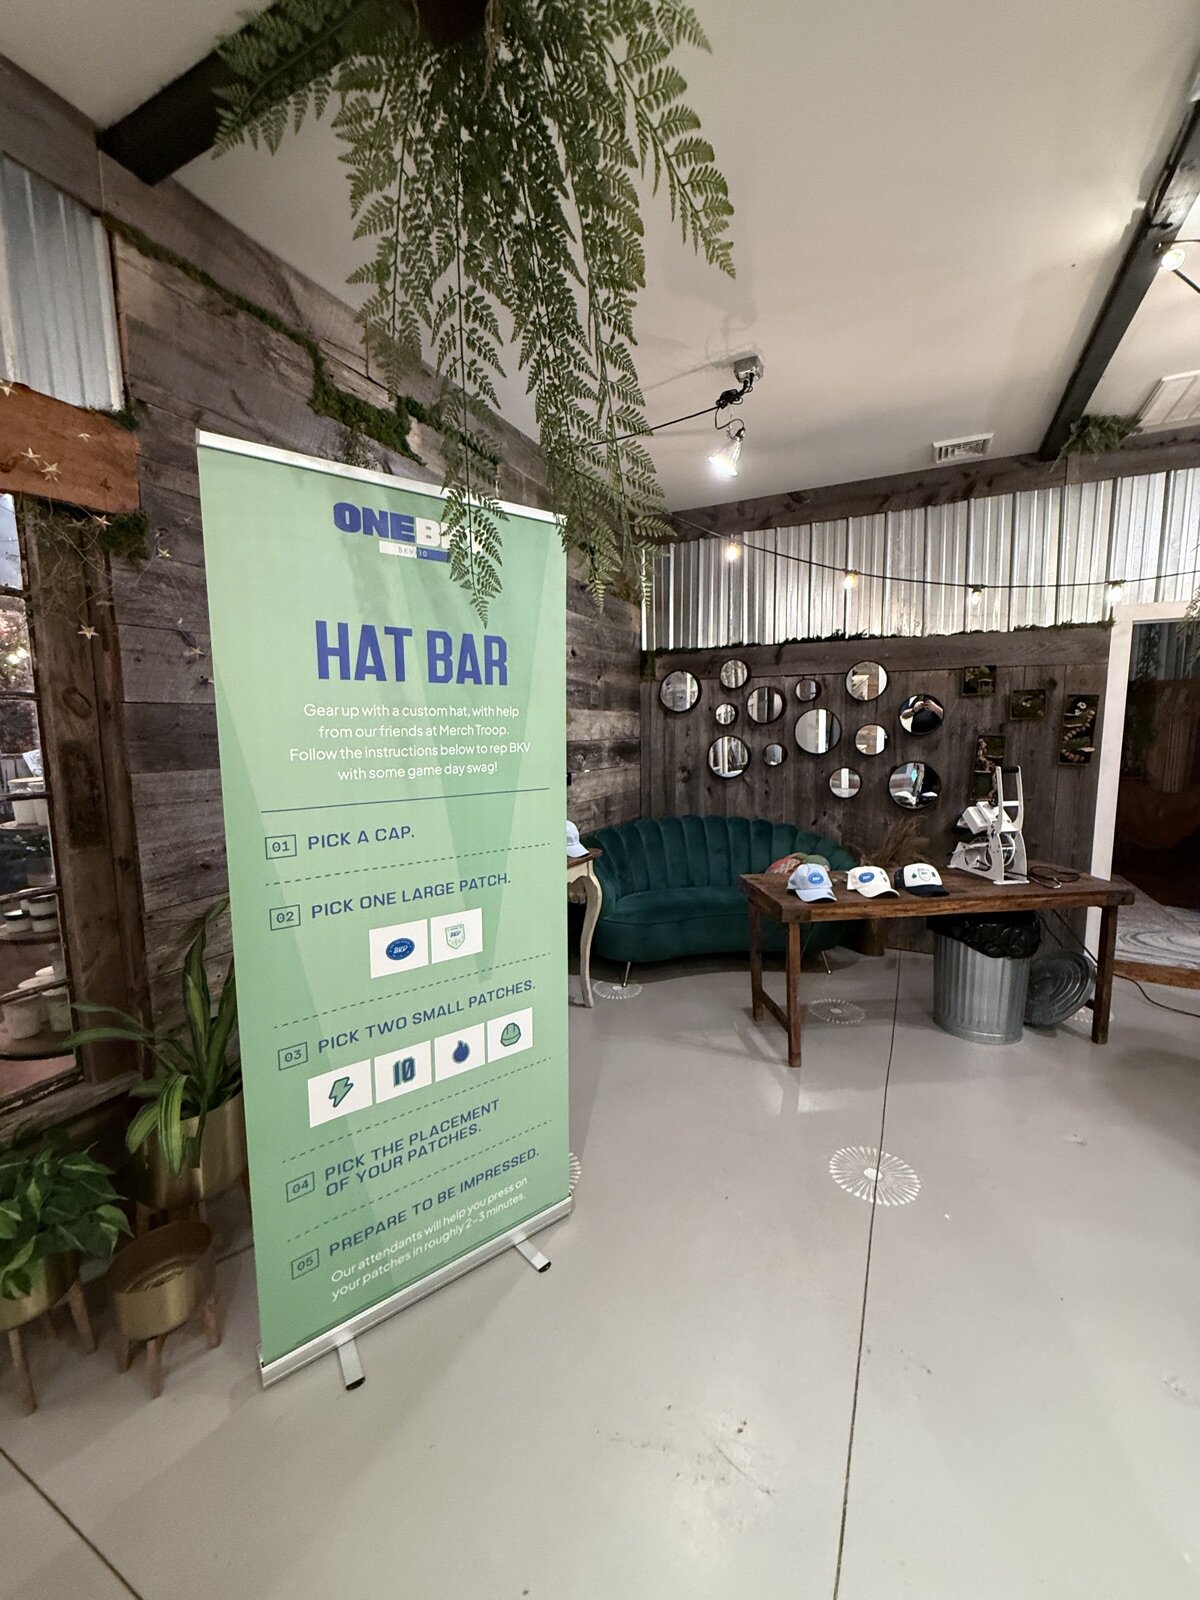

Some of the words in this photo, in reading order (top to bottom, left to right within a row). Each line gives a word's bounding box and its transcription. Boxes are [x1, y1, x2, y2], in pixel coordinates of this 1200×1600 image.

[315, 620, 412, 682] HAT
[427, 629, 508, 686] BAR
[304, 704, 339, 717] Gear
[342, 706, 360, 719] up
[362, 704, 390, 717] with
[392, 708, 400, 717] a
[402, 706, 448, 717] custom
[450, 705, 470, 718] hat,
[472, 705, 495, 717] with
[496, 706, 519, 718] help
[318, 726, 352, 738] from
[355, 727, 378, 738] our
[379, 725, 423, 737] friends
[425, 726, 438, 736] at
[440, 724, 474, 736] Merch
[475, 724, 509, 737] Troop.
[290, 748, 337, 762] Follow
[340, 747, 362, 759] the
[364, 745, 438, 758] instructions
[440, 743, 474, 756] below
[477, 744, 487, 754] to
[490, 743, 508, 756] rep
[510, 742, 530, 753] BKV
[338, 768, 366, 780] with
[370, 768, 405, 778] some
[408, 766, 442, 780] game
[444, 764, 464, 776] day
[467, 762, 498, 774] swag!
[272, 841, 290, 852] 01
[308, 832, 350, 850] PICK
[357, 830, 370, 844] A
[375, 826, 416, 842] CAP.
[276, 911, 294, 923] 02
[312, 899, 354, 918] PICK
[360, 892, 396, 909] ONE
[402, 882, 455, 902] LARGE
[460, 872, 511, 892] PATCH.
[284, 1050, 302, 1062] 03
[318, 1030, 359, 1053] PICK
[366, 1017, 407, 1038] TWO
[412, 1000, 464, 1025] SMALL
[468, 979, 536, 1008] PATCHES.
[393, 1056, 416, 1088] 10
[292, 1180, 309, 1194] 04
[324, 1154, 365, 1180] PICK
[371, 1138, 404, 1160] THE
[410, 1100, 500, 1146] PLACEMENT
[326, 1176, 350, 1197] OF
[356, 1156, 403, 1183] YOUR
[408, 1123, 482, 1161] PATCHES.
[297, 1256, 314, 1271] 05
[329, 1210, 407, 1256] PREPARE
[412, 1198, 432, 1215] TO
[438, 1186, 456, 1205] BE
[460, 1148, 540, 1193] IMPRESSED.
[330, 1264, 357, 1282] Our
[358, 1230, 423, 1271] attendants
[424, 1218, 442, 1236] will
[443, 1207, 466, 1226] help
[464, 1197, 487, 1218] you
[488, 1185, 514, 1208] press
[515, 1177, 528, 1190] on
[332, 1280, 362, 1302] your
[363, 1252, 411, 1286] patches
[413, 1244, 423, 1256] in
[424, 1225, 464, 1252] roughly
[486, 1194, 526, 1218] minutes.
